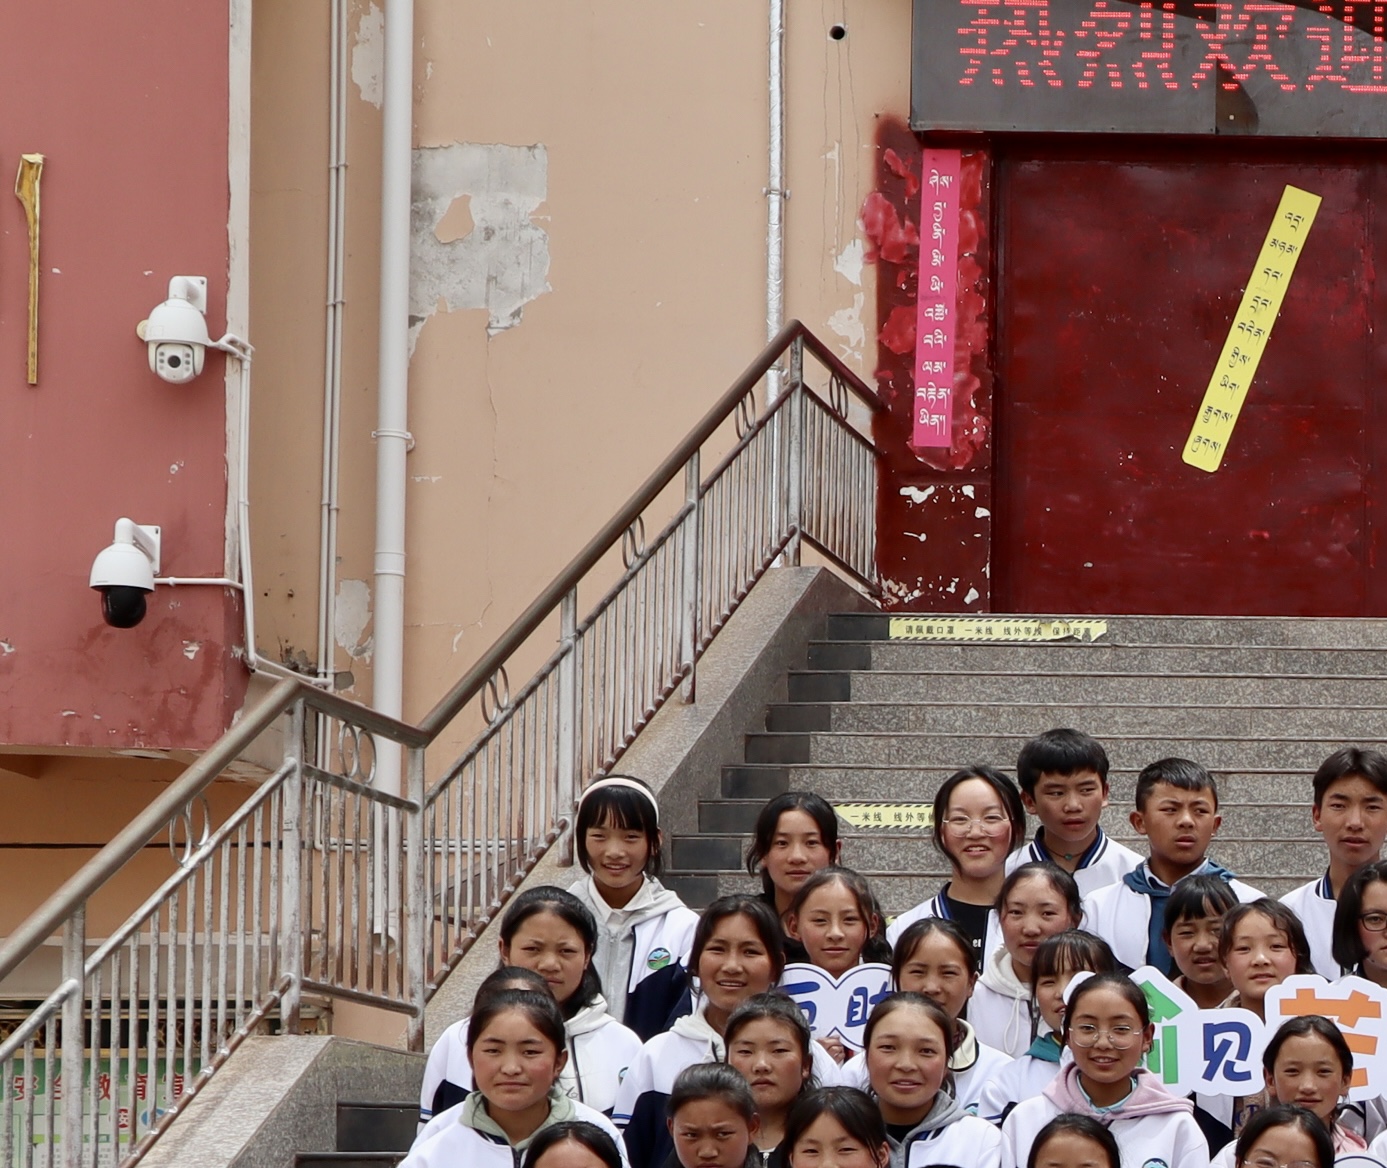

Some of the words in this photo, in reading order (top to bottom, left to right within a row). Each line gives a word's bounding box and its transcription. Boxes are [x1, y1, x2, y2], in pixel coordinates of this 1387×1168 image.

[905, 625, 955, 635] 请佩戴口罩
[965, 626, 994, 636] 一米线
